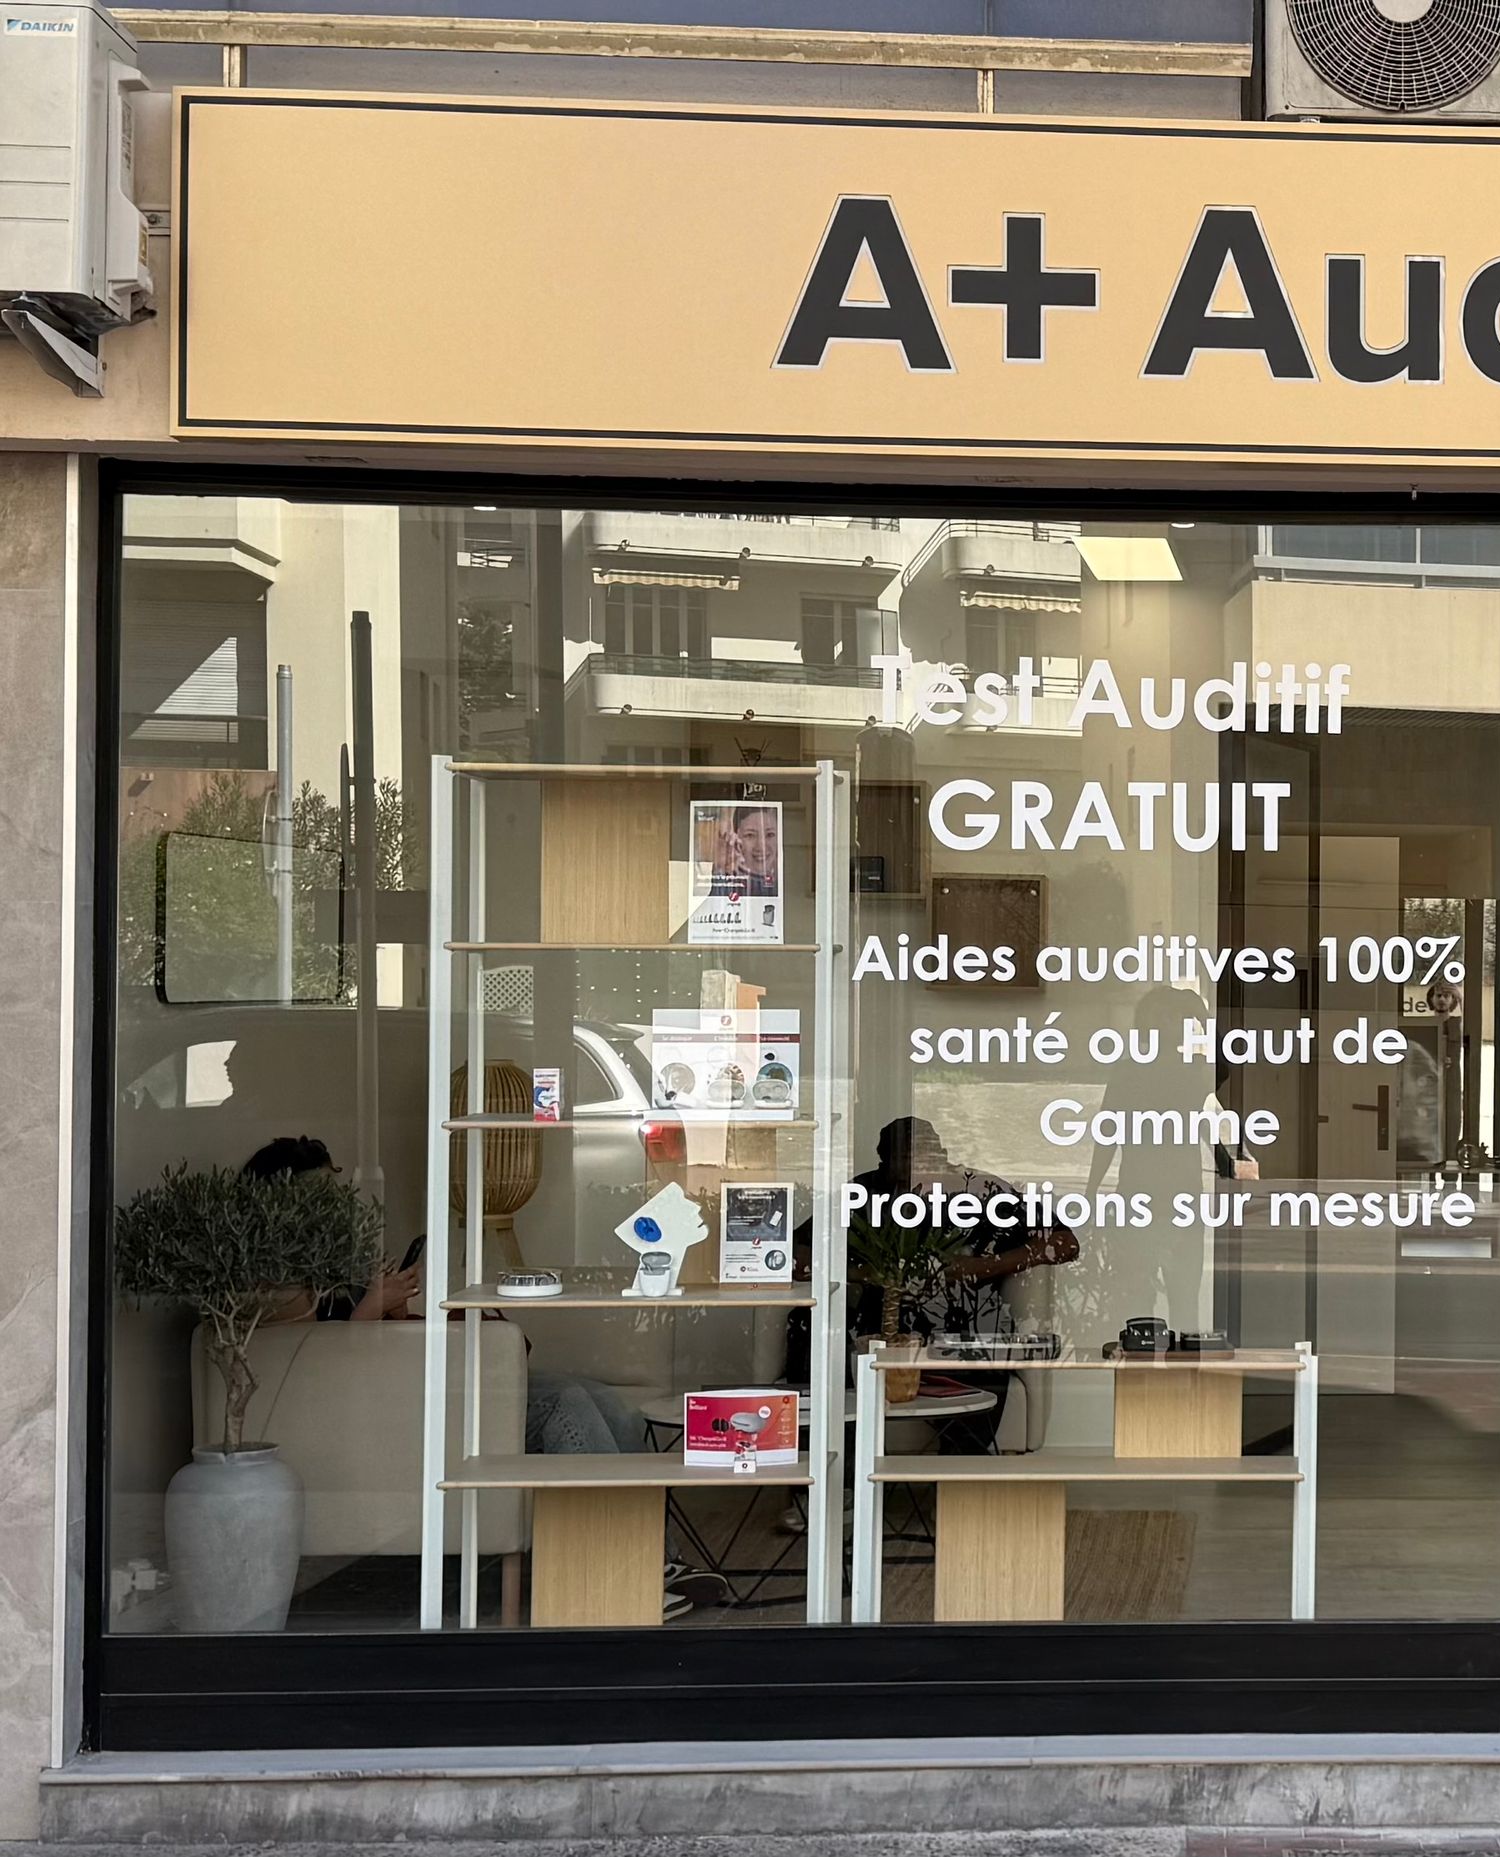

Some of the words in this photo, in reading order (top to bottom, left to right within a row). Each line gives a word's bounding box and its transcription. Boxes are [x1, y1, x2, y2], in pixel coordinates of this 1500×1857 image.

[20, 22, 74, 32] DAIKIN
[770, 194, 1100, 374] A+
[870, 654, 1040, 728] Test
[1067, 658, 1353, 734] Auditif
[928, 778, 1292, 853] GRATUIT
[852, 933, 1016, 984] Aides
[1035, 935, 1296, 984] auditives
[1318, 935, 1466, 986] 100%
[909, 1012, 1069, 1064] santé
[1088, 1026, 1159, 1064] ou
[1183, 1017, 1315, 1064] Haut
[1332, 1017, 1409, 1064] de
[1039, 1098, 1281, 1146] Gamme
[839, 1181, 1153, 1228] Protections
[1171, 1189, 1252, 1228] sur
[1269, 1189, 1476, 1228] mesure
